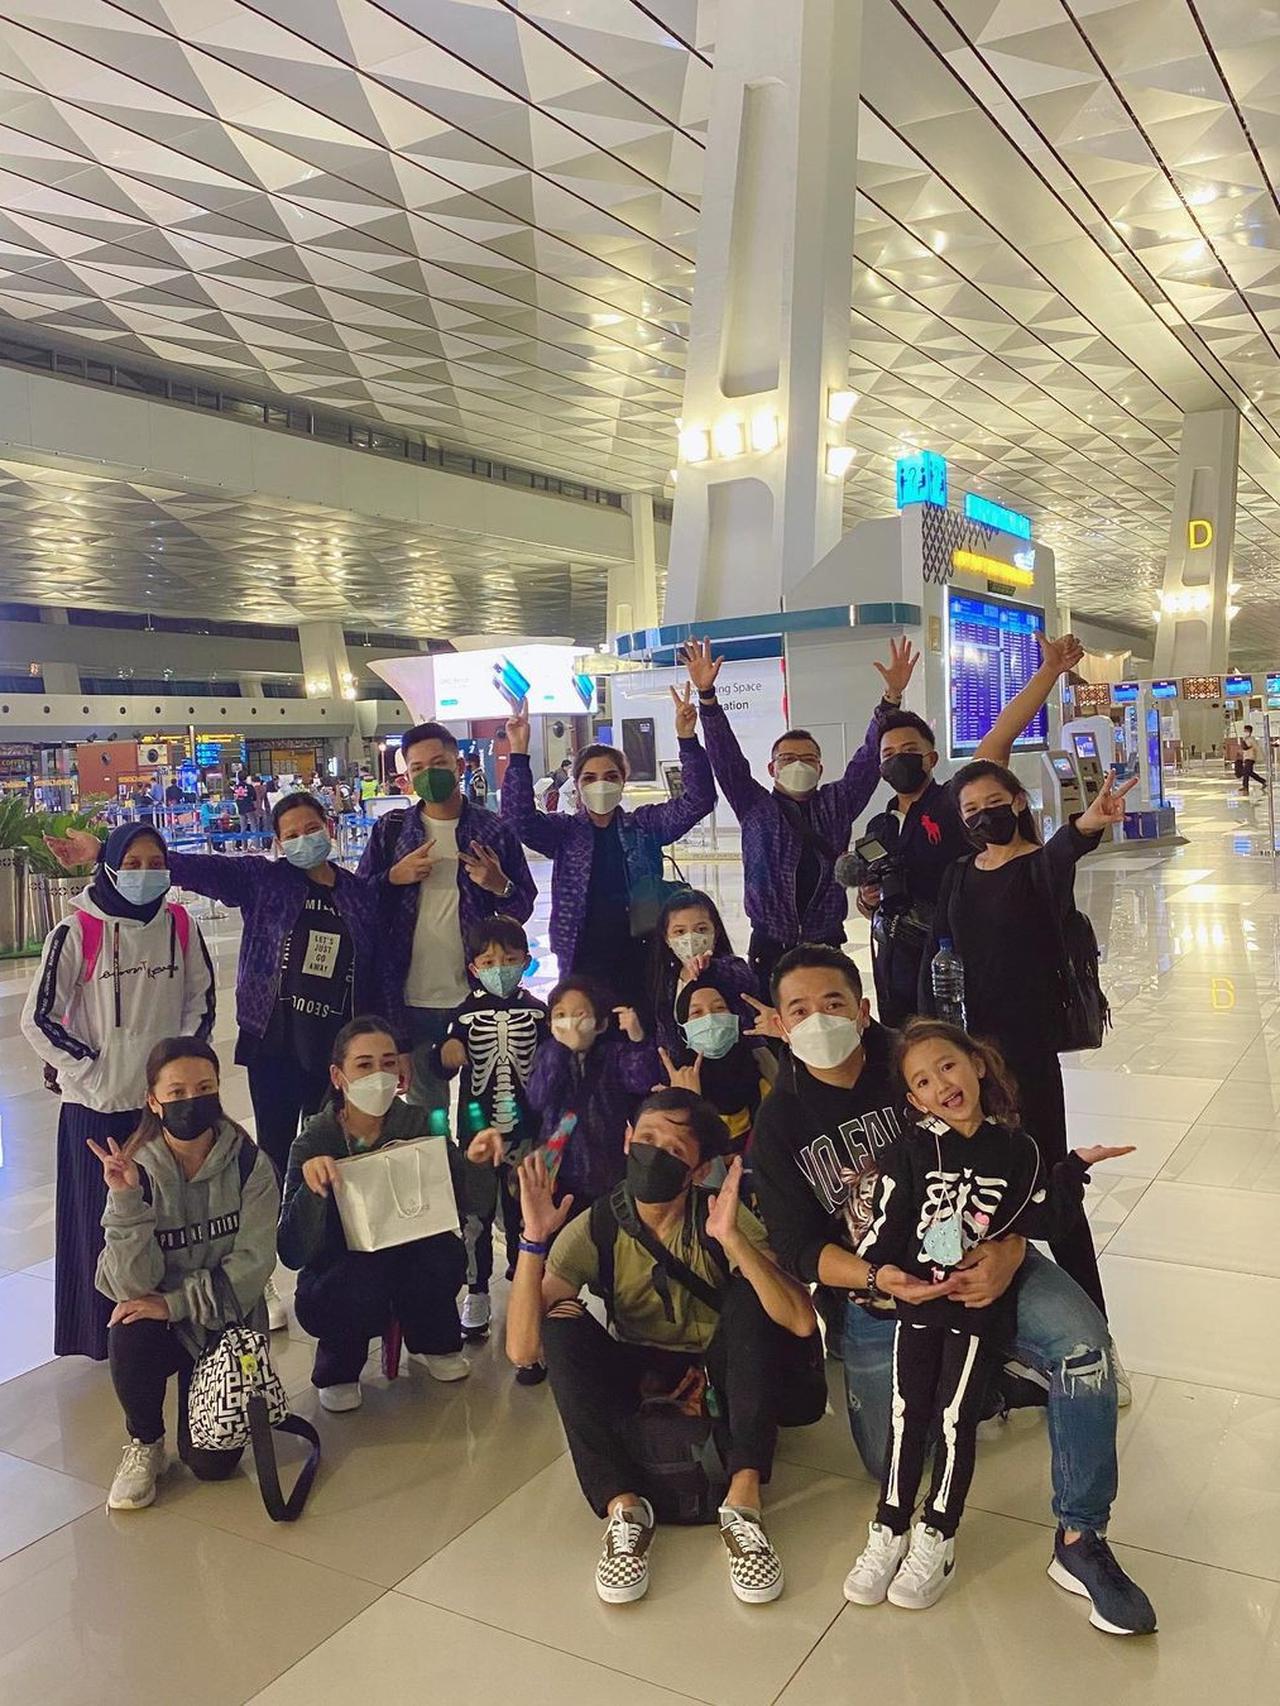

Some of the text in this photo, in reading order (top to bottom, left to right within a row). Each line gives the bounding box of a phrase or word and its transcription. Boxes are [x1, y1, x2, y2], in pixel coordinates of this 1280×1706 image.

[1189, 519, 1212, 549] D
[733, 682, 762, 692] Space
[314, 935, 334, 945] LET'S
[314, 944, 332, 953] JUST
[315, 953, 326, 962] GO
[309, 961, 328, 972] AWAY
[292, 995, 330, 1017] SEOUL
[793, 1134, 851, 1215] NO
